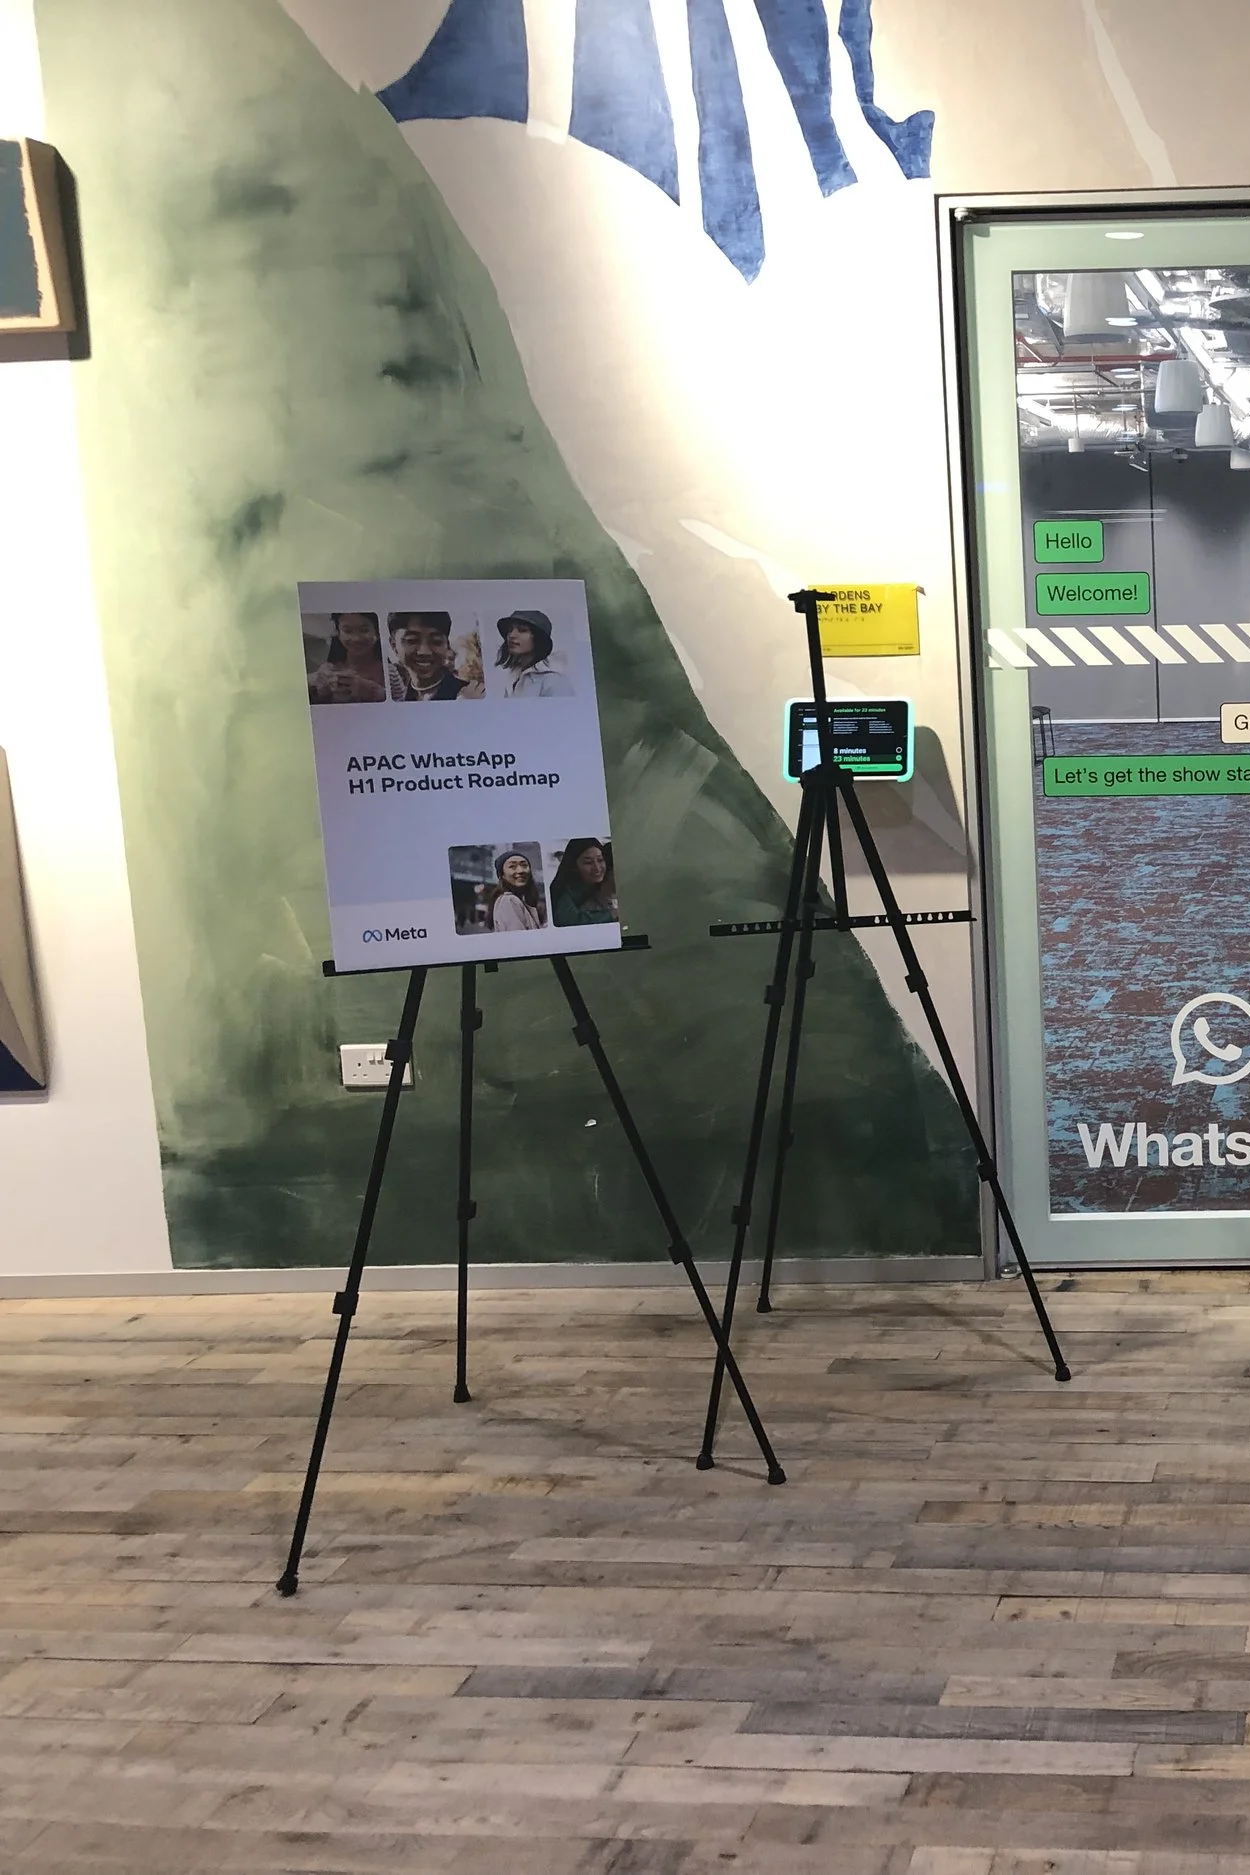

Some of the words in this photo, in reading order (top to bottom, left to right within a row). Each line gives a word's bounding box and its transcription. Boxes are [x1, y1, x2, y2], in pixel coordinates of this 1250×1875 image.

[1045, 532, 1092, 550] Hello
[823, 590, 871, 600] RDENS
[1047, 584, 1138, 602] Welcome!
[833, 603, 857, 613] THE
[860, 603, 883, 613] BAY
[347, 754, 406, 772] APAC
[410, 751, 516, 769] WhatsApp
[349, 778, 375, 794] H1
[381, 775, 463, 793] Product
[468, 771, 560, 788] Roadmap
[1103, 769, 1133, 787] get
[1138, 767, 1167, 783] the
[1172, 766, 1221, 782] show
[385, 926, 428, 942] Meta
